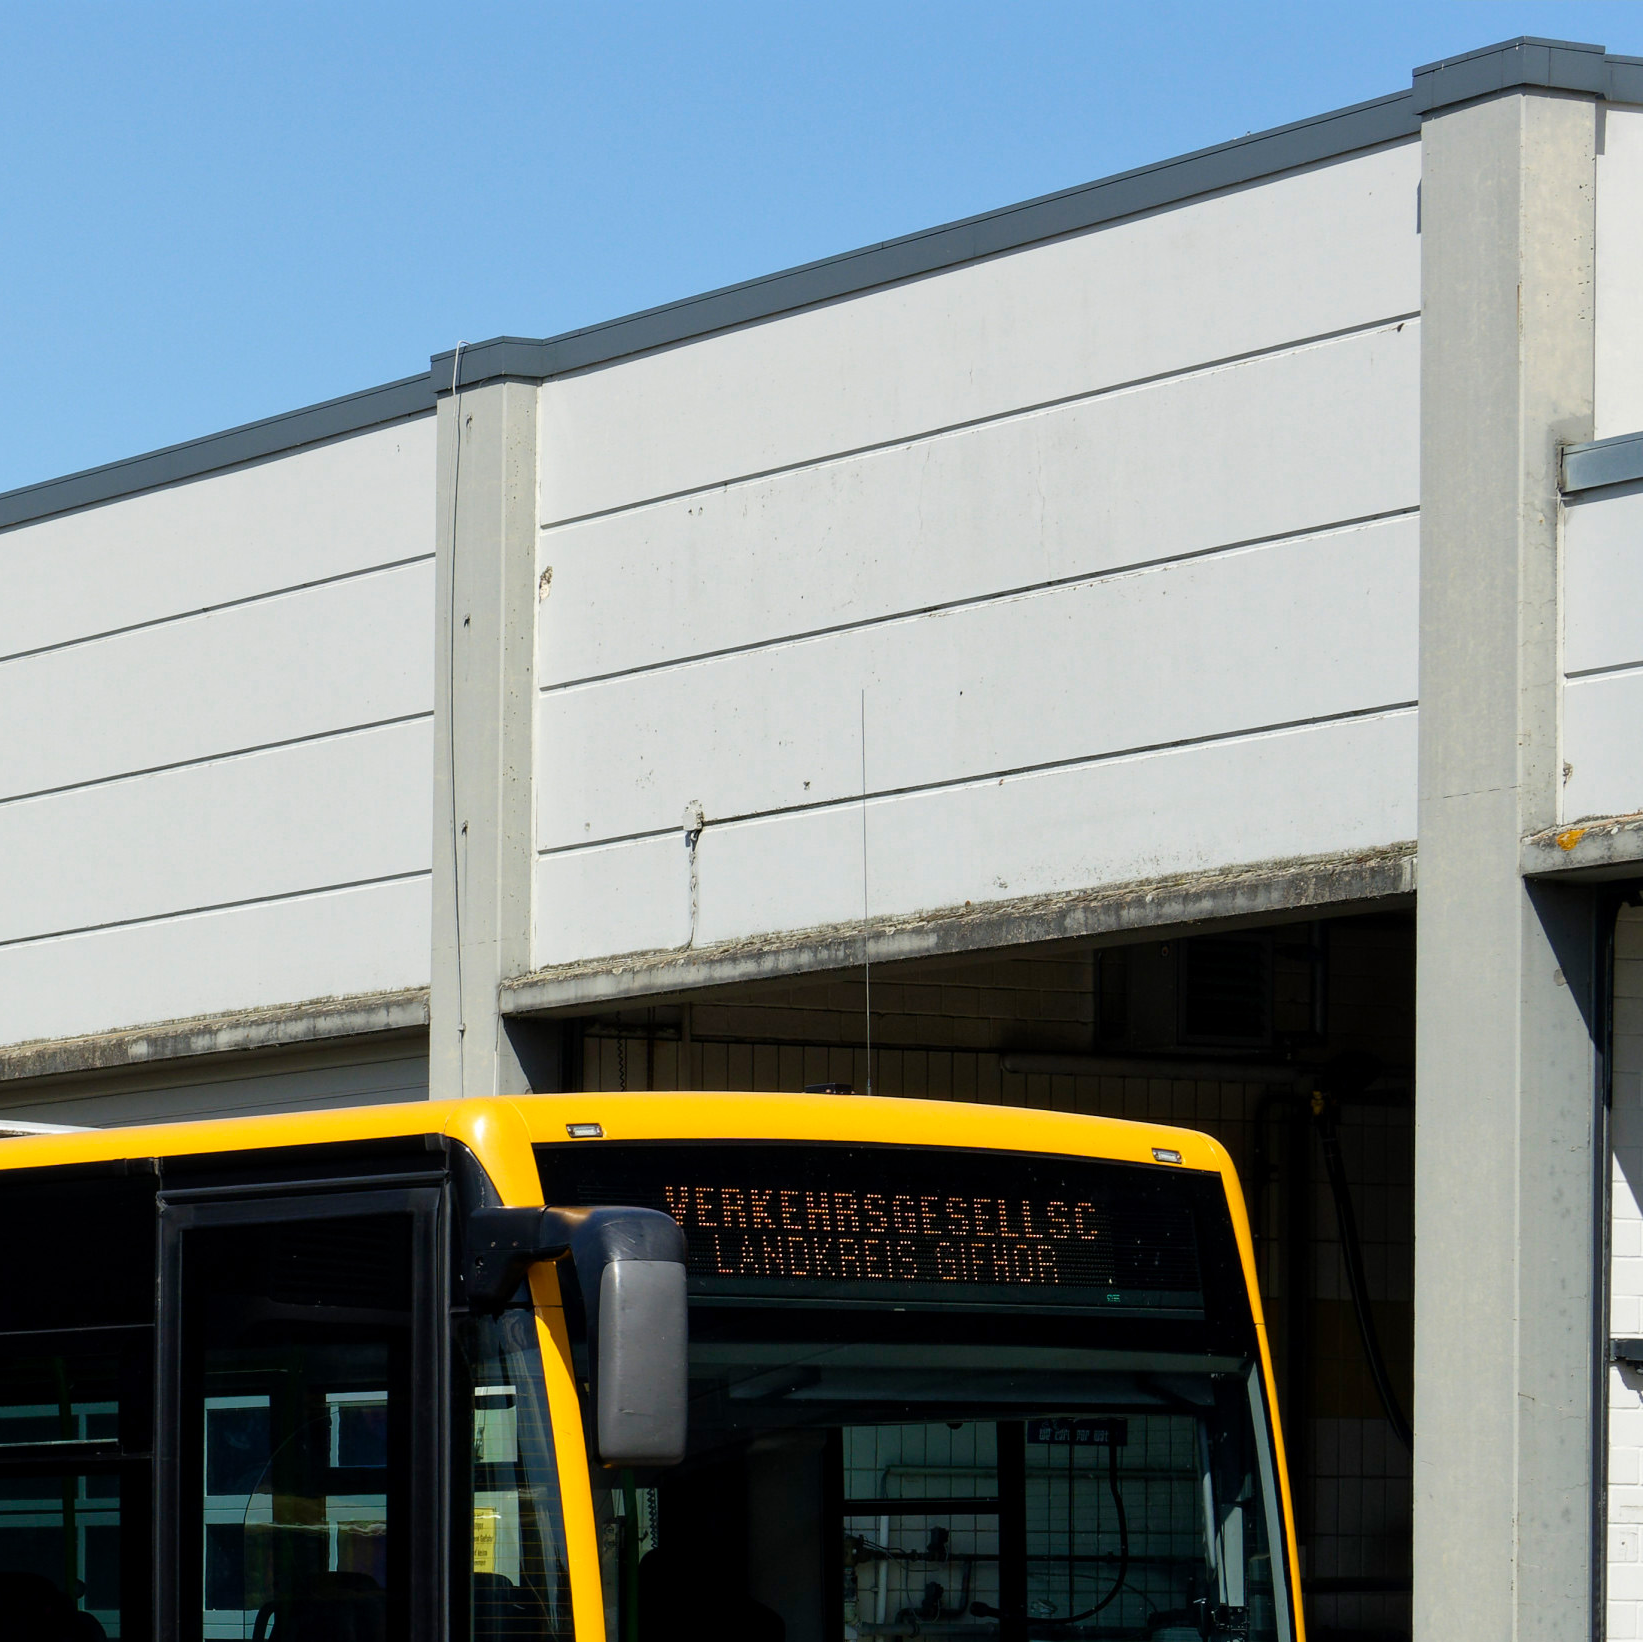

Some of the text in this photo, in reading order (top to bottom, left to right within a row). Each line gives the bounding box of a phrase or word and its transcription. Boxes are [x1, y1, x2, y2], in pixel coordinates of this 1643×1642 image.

[664, 1185, 1098, 1240] VERKEHRSGESELLSC
[713, 1233, 1060, 1284] LANDKREIS GIFHOR
